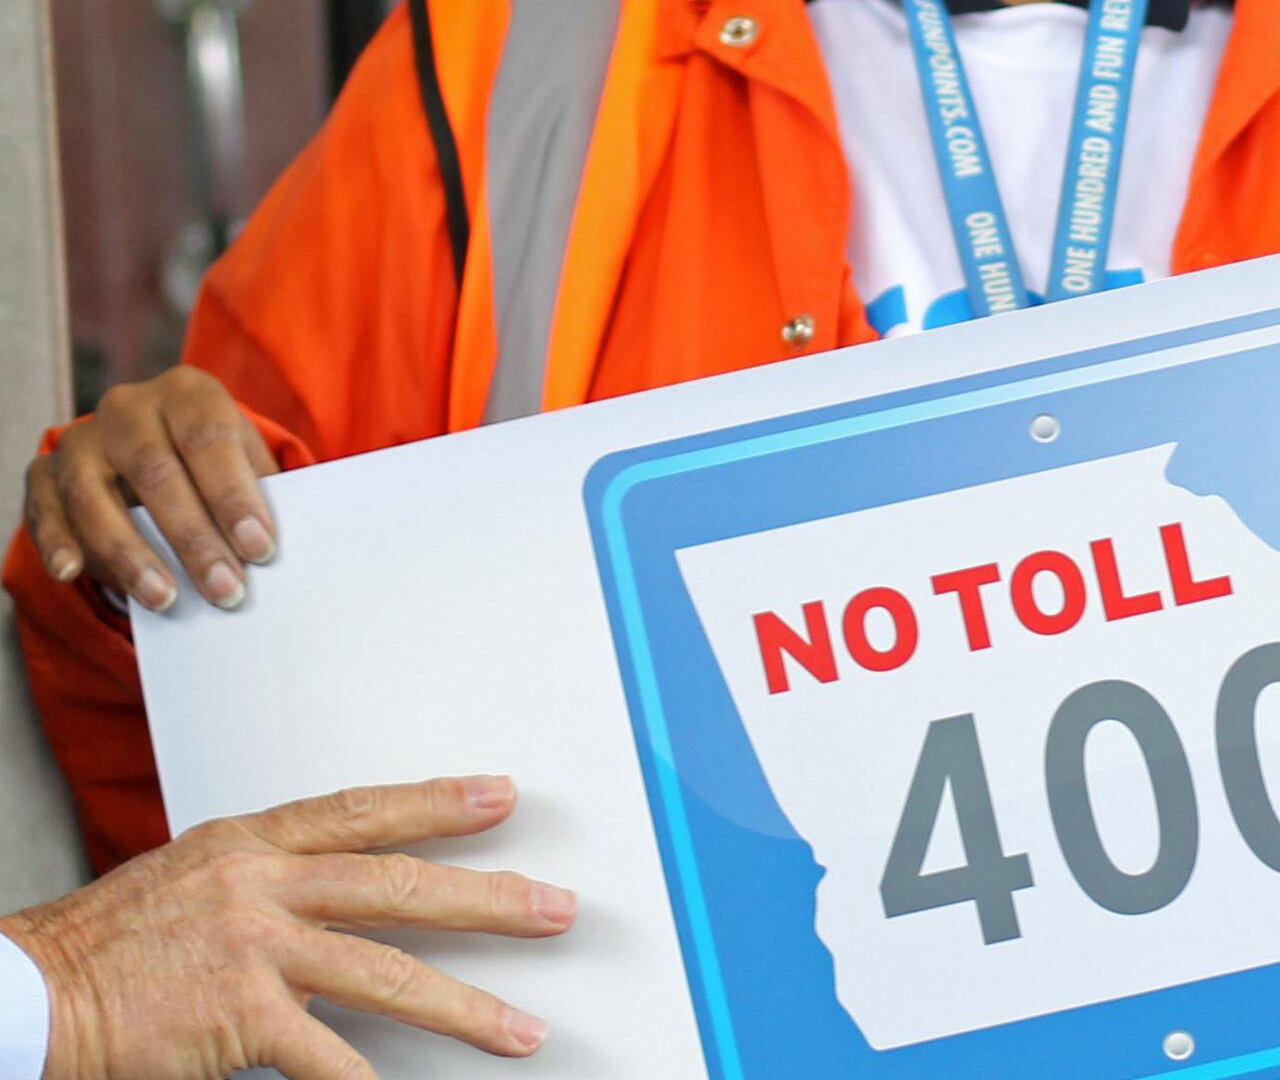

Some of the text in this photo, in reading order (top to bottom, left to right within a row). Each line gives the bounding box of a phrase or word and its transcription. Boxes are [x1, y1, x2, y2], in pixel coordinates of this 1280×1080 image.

[1091, 35, 1127, 81] FUN
[1084, 83, 1120, 133] AND
[1069, 136, 1113, 243] HUNDRED
[965, 210, 1003, 259] ONE
[978, 261, 1018, 313] HUN
[1061, 246, 1097, 294] ONE
[755, 524, 1232, 693] NO TOLL
